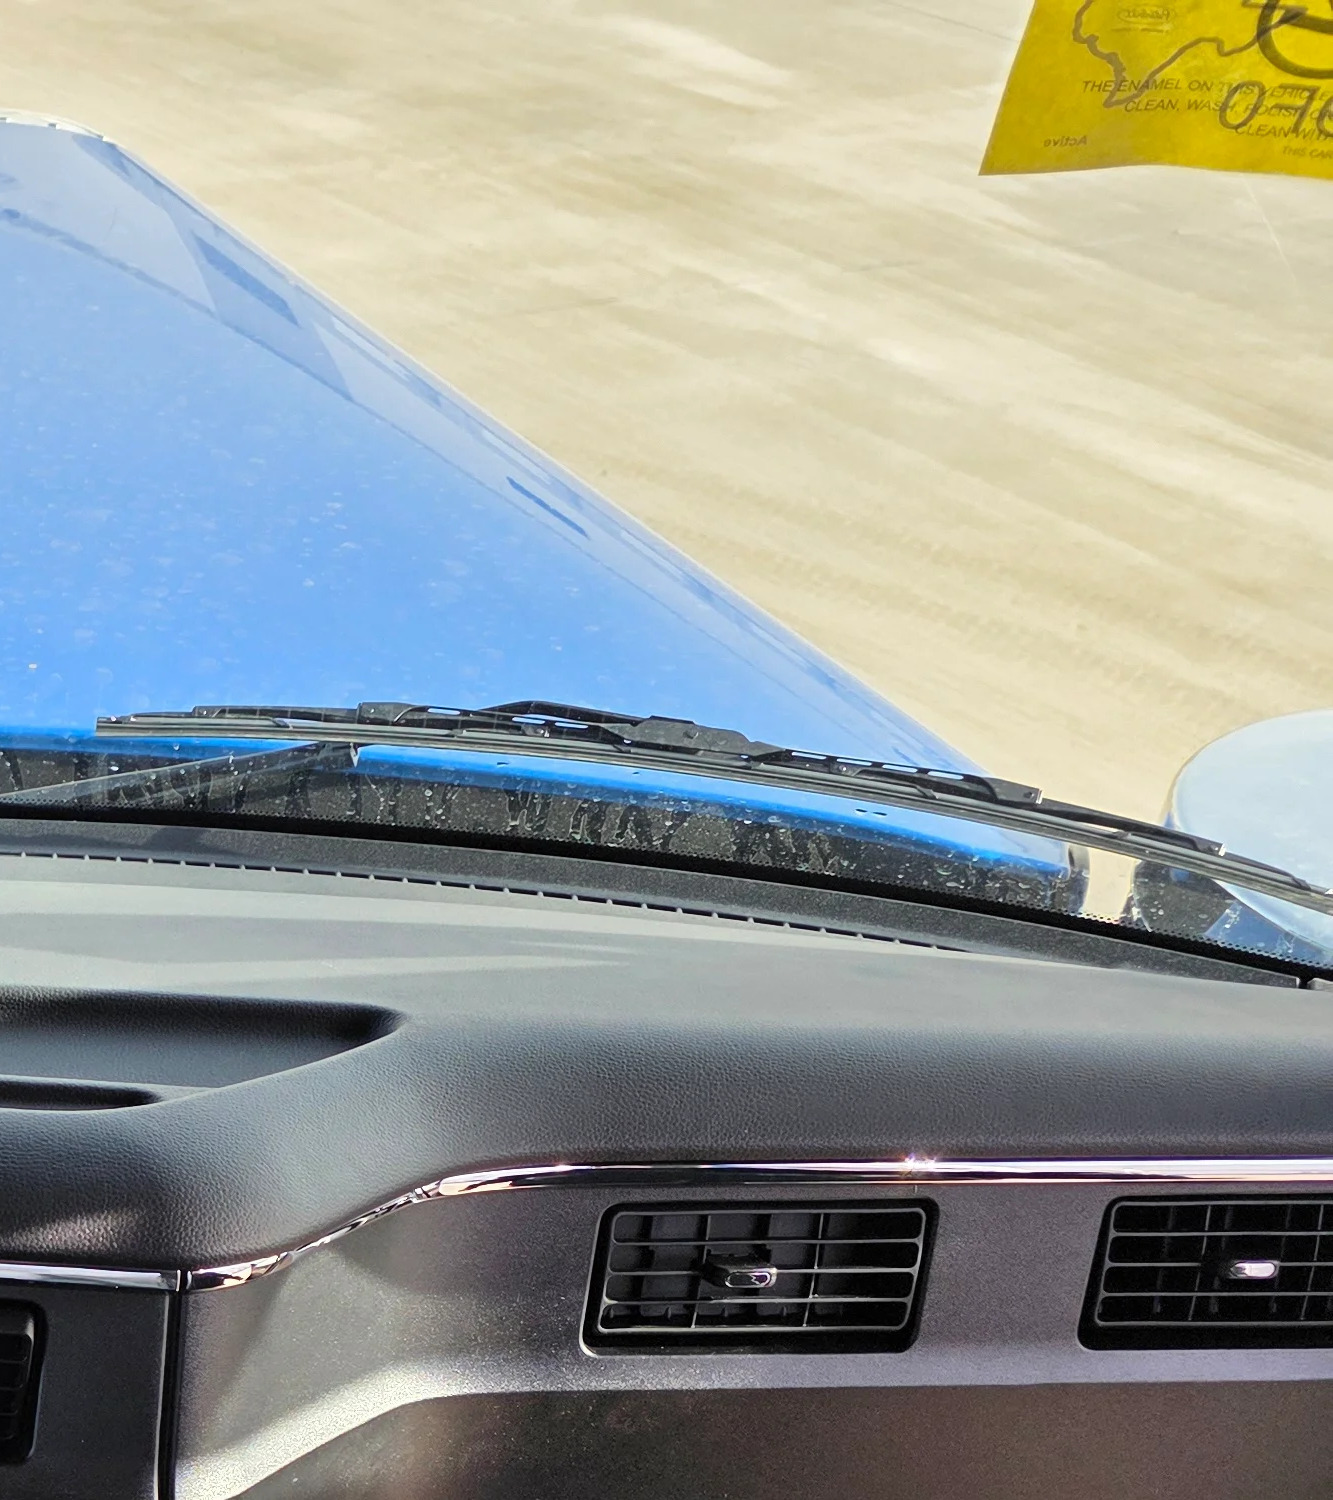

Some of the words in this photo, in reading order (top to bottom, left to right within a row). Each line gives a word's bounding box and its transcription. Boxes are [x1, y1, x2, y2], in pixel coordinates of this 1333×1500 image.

[1083, 80, 1115, 92] THE
[1116, 78, 1182, 92] ENAMEL
[1188, 79, 1213, 92] ON
